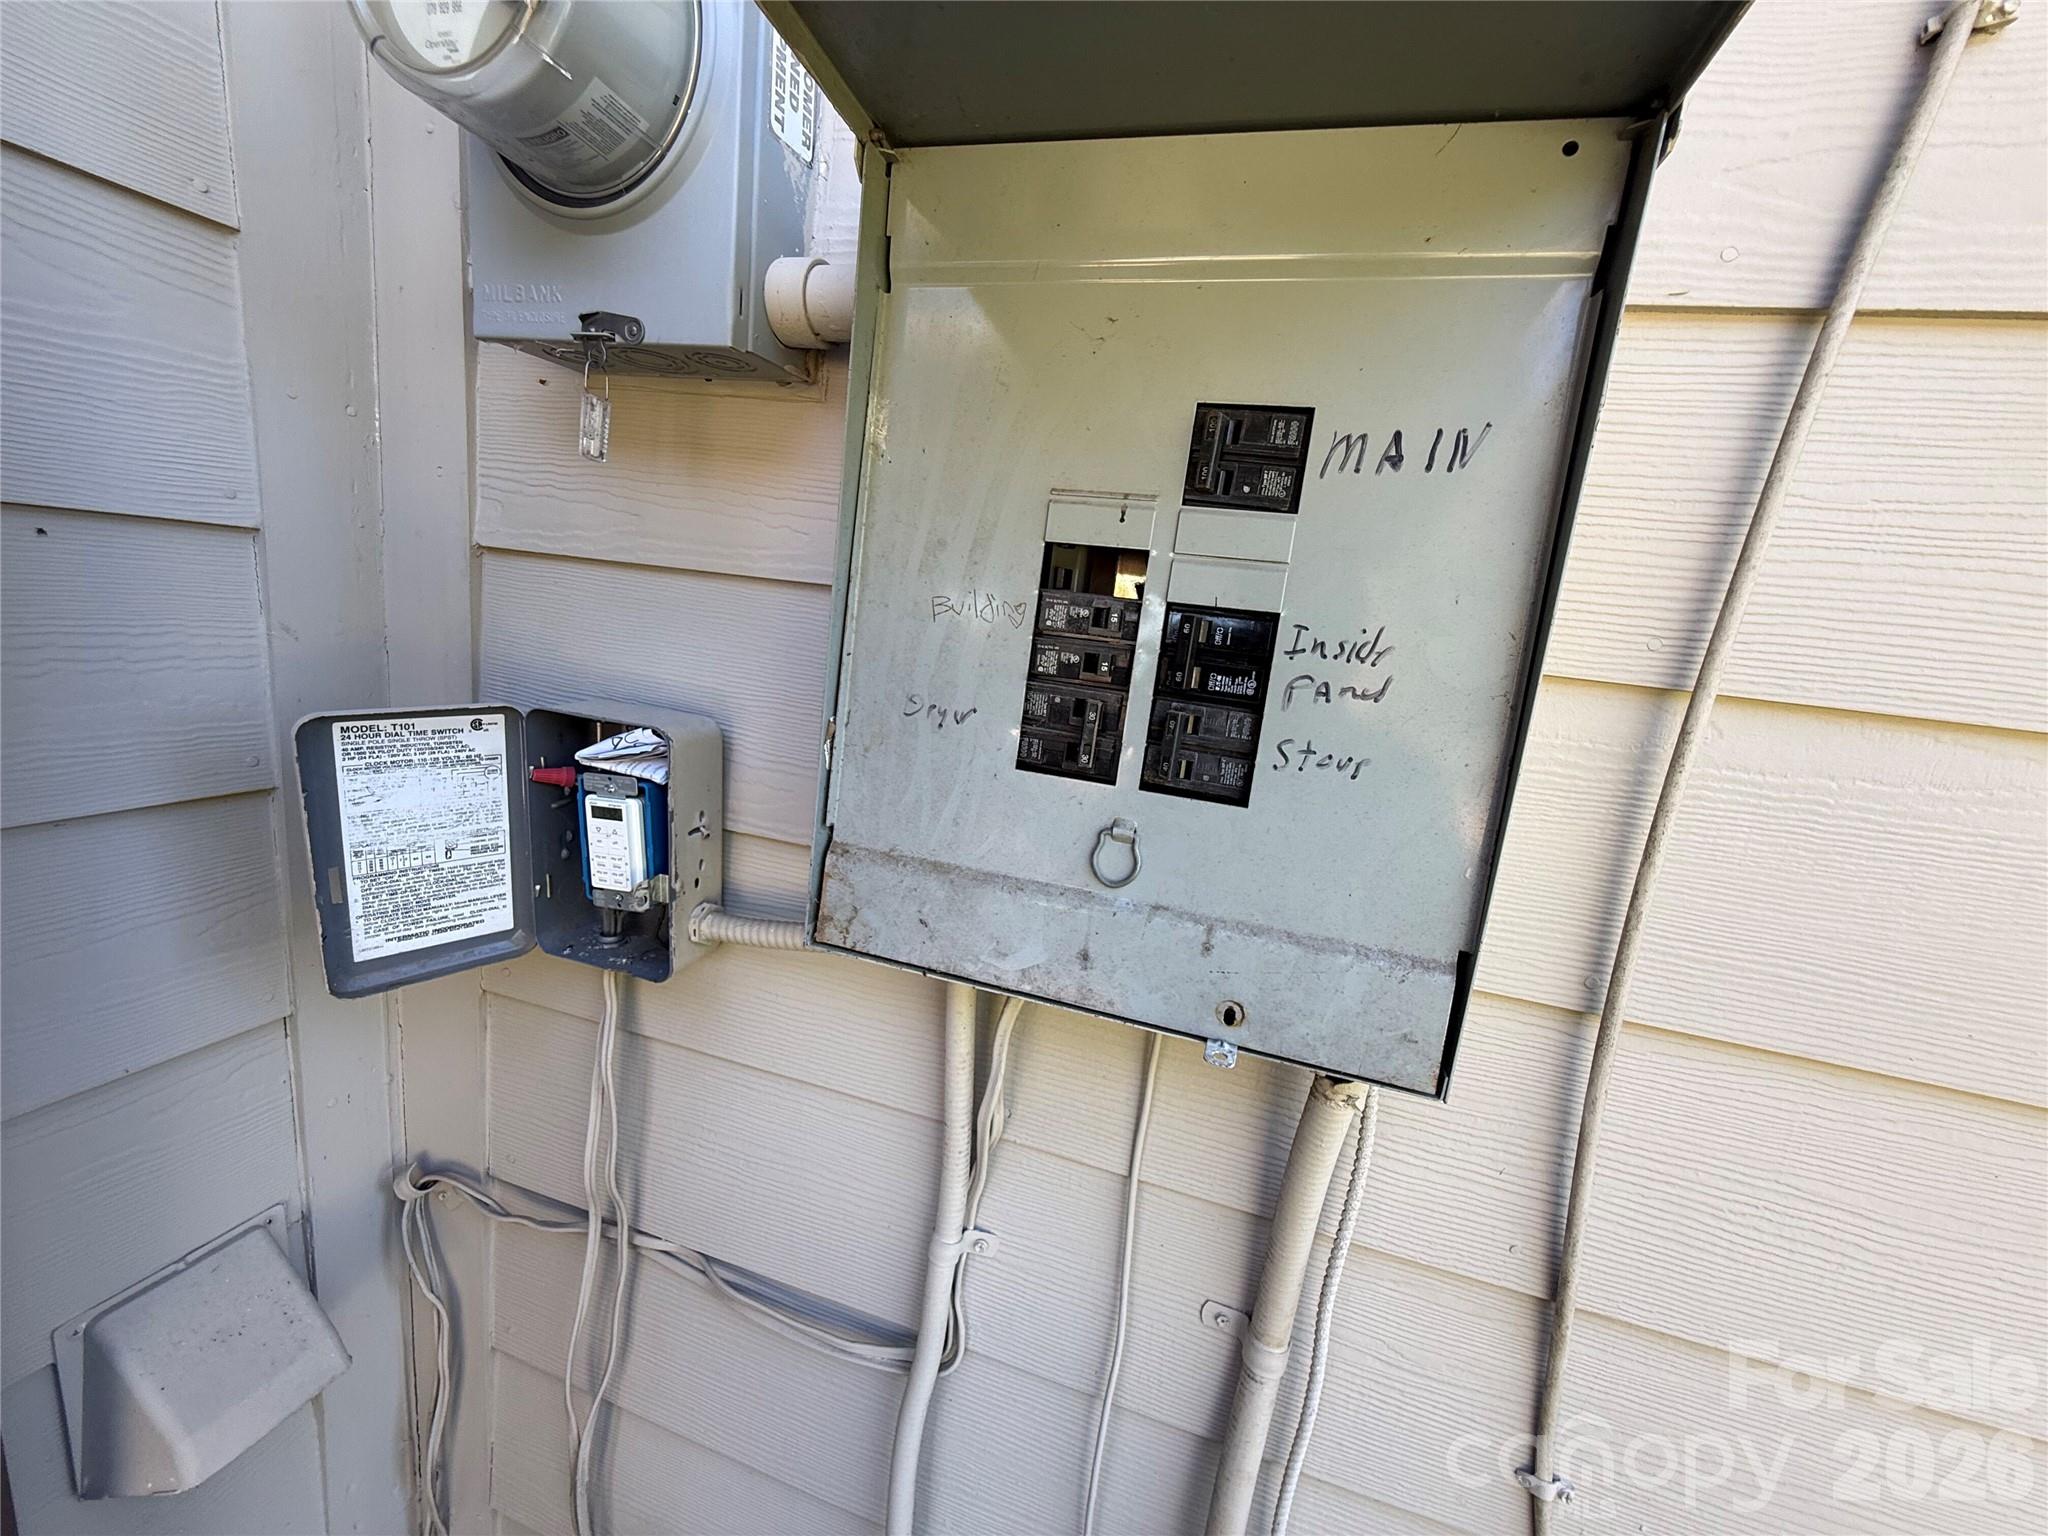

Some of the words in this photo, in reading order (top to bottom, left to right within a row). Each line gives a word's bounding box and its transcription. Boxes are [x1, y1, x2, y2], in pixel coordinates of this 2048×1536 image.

[1320, 421, 1491, 479] MAIN
[1111, 613, 1118, 623] 15
[1183, 623, 1191, 634] 60
[1101, 662, 1109, 672] 15
[1175, 671, 1183, 682] 60
[1088, 711, 1097, 721] 30
[340, 724, 386, 733] MODEL:
[390, 722, 415, 730] T101
[1081, 754, 1089, 764] 30
